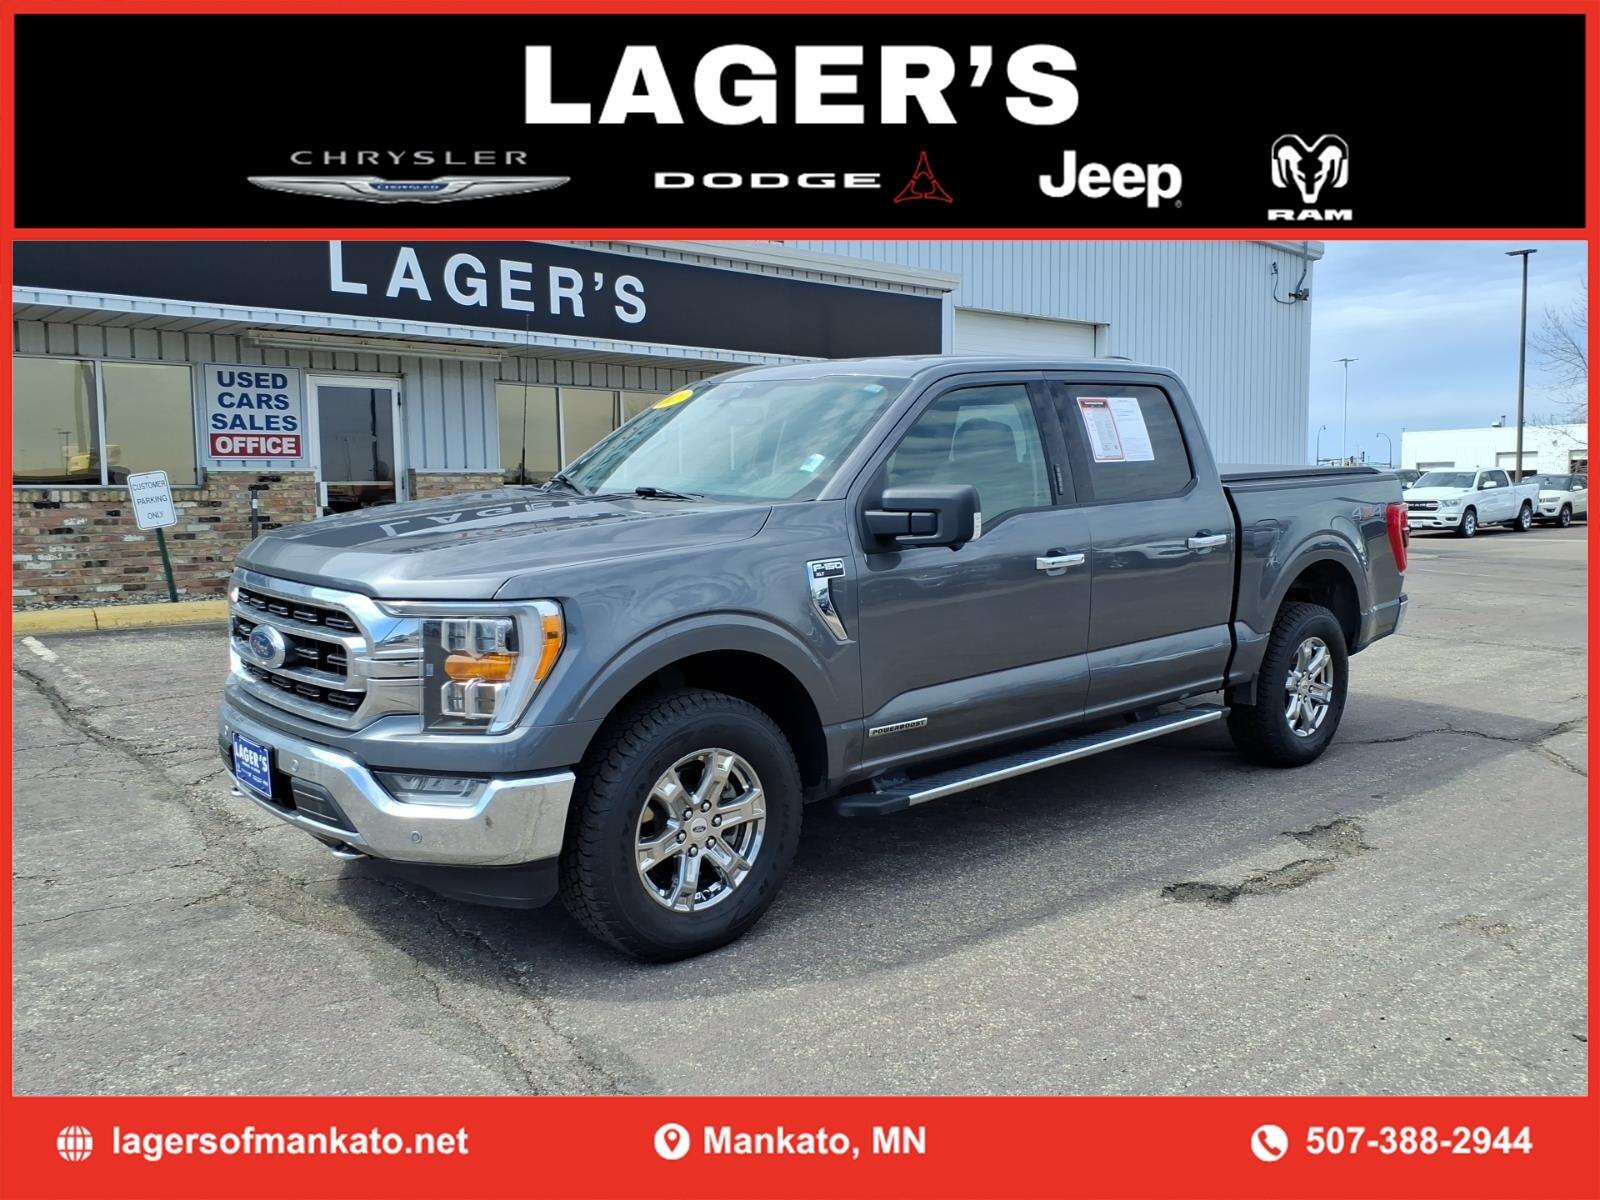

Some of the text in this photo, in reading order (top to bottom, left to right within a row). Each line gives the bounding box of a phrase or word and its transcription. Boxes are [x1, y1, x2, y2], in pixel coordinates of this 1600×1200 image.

[329, 240, 647, 324] LAGER’S
[217, 370, 288, 390] USED
[217, 392, 290, 410] CARS
[211, 413, 298, 432] SALES
[215, 436, 297, 454] OFFICE
[132, 480, 167, 491] CUSTOMER
[136, 494, 168, 505] PARKING
[147, 511, 165, 520] ONLY
[813, 561, 843, 572] F-150
[872, 720, 925, 735] POWERBOOST
